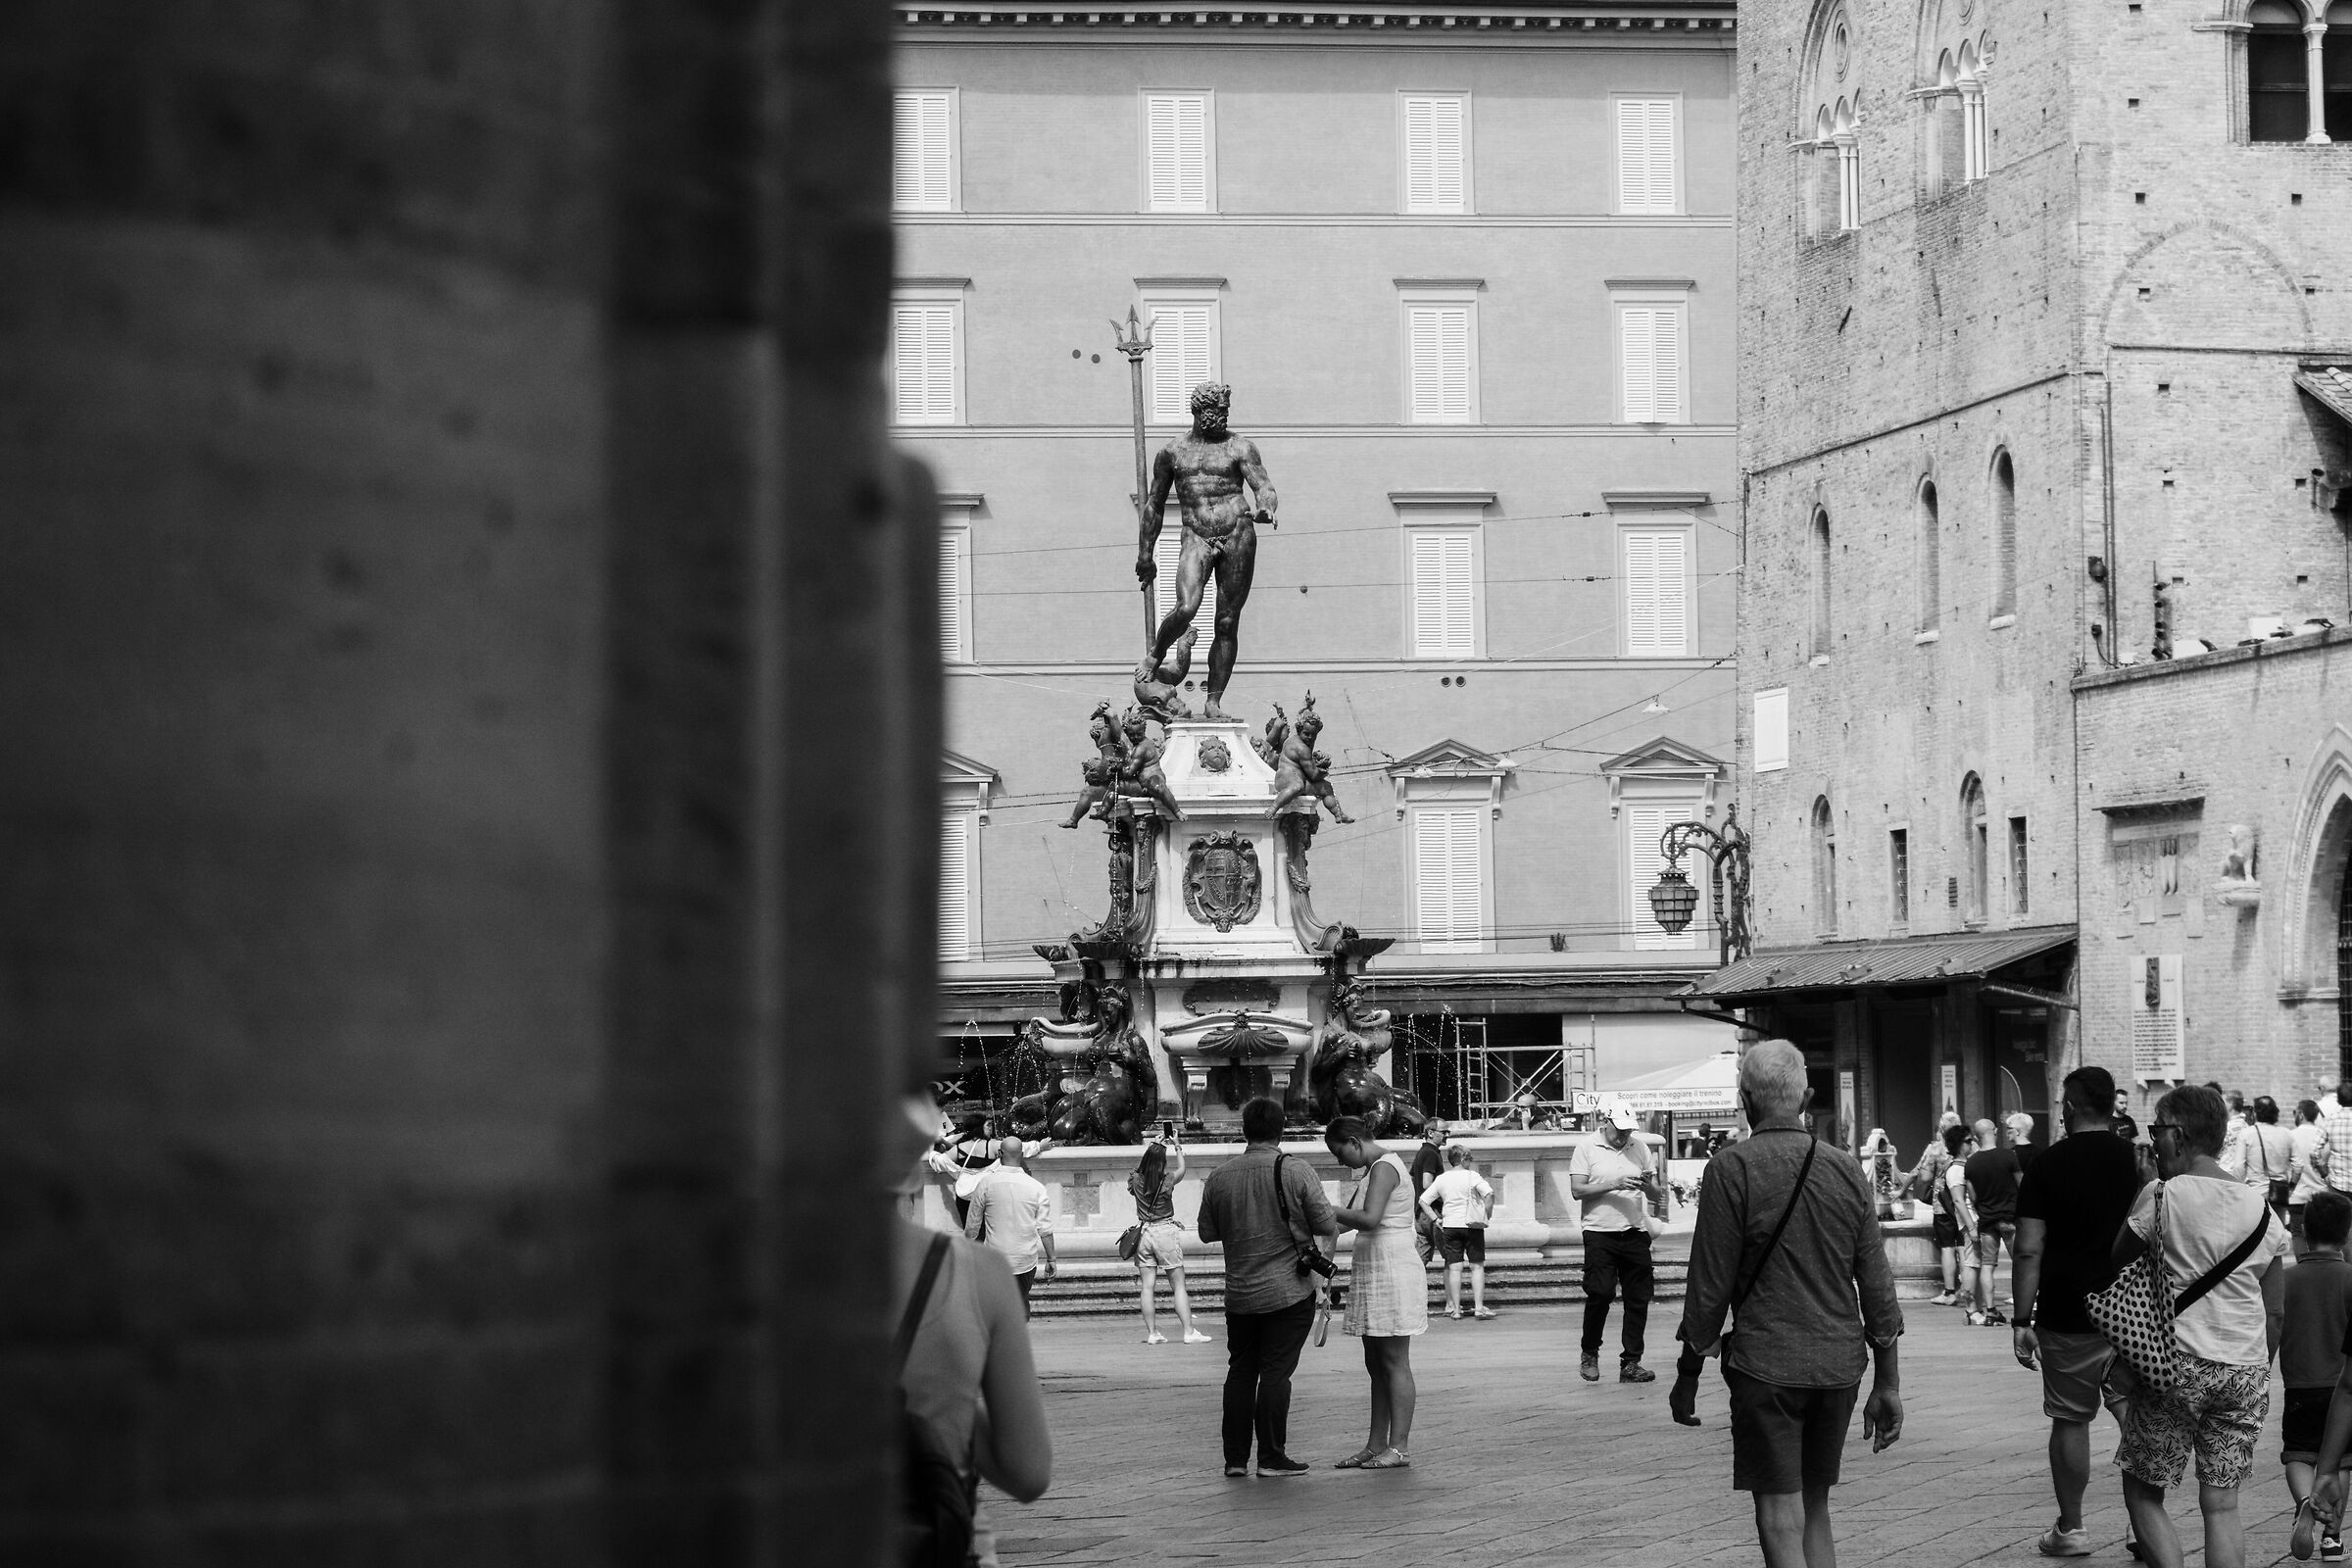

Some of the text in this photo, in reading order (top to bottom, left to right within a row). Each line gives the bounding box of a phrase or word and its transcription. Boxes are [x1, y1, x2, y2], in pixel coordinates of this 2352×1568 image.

[1577, 1093, 1600, 1108] City
[1617, 1092, 1639, 1101] Scopri
[1659, 1090, 1692, 1101] noleggiare
